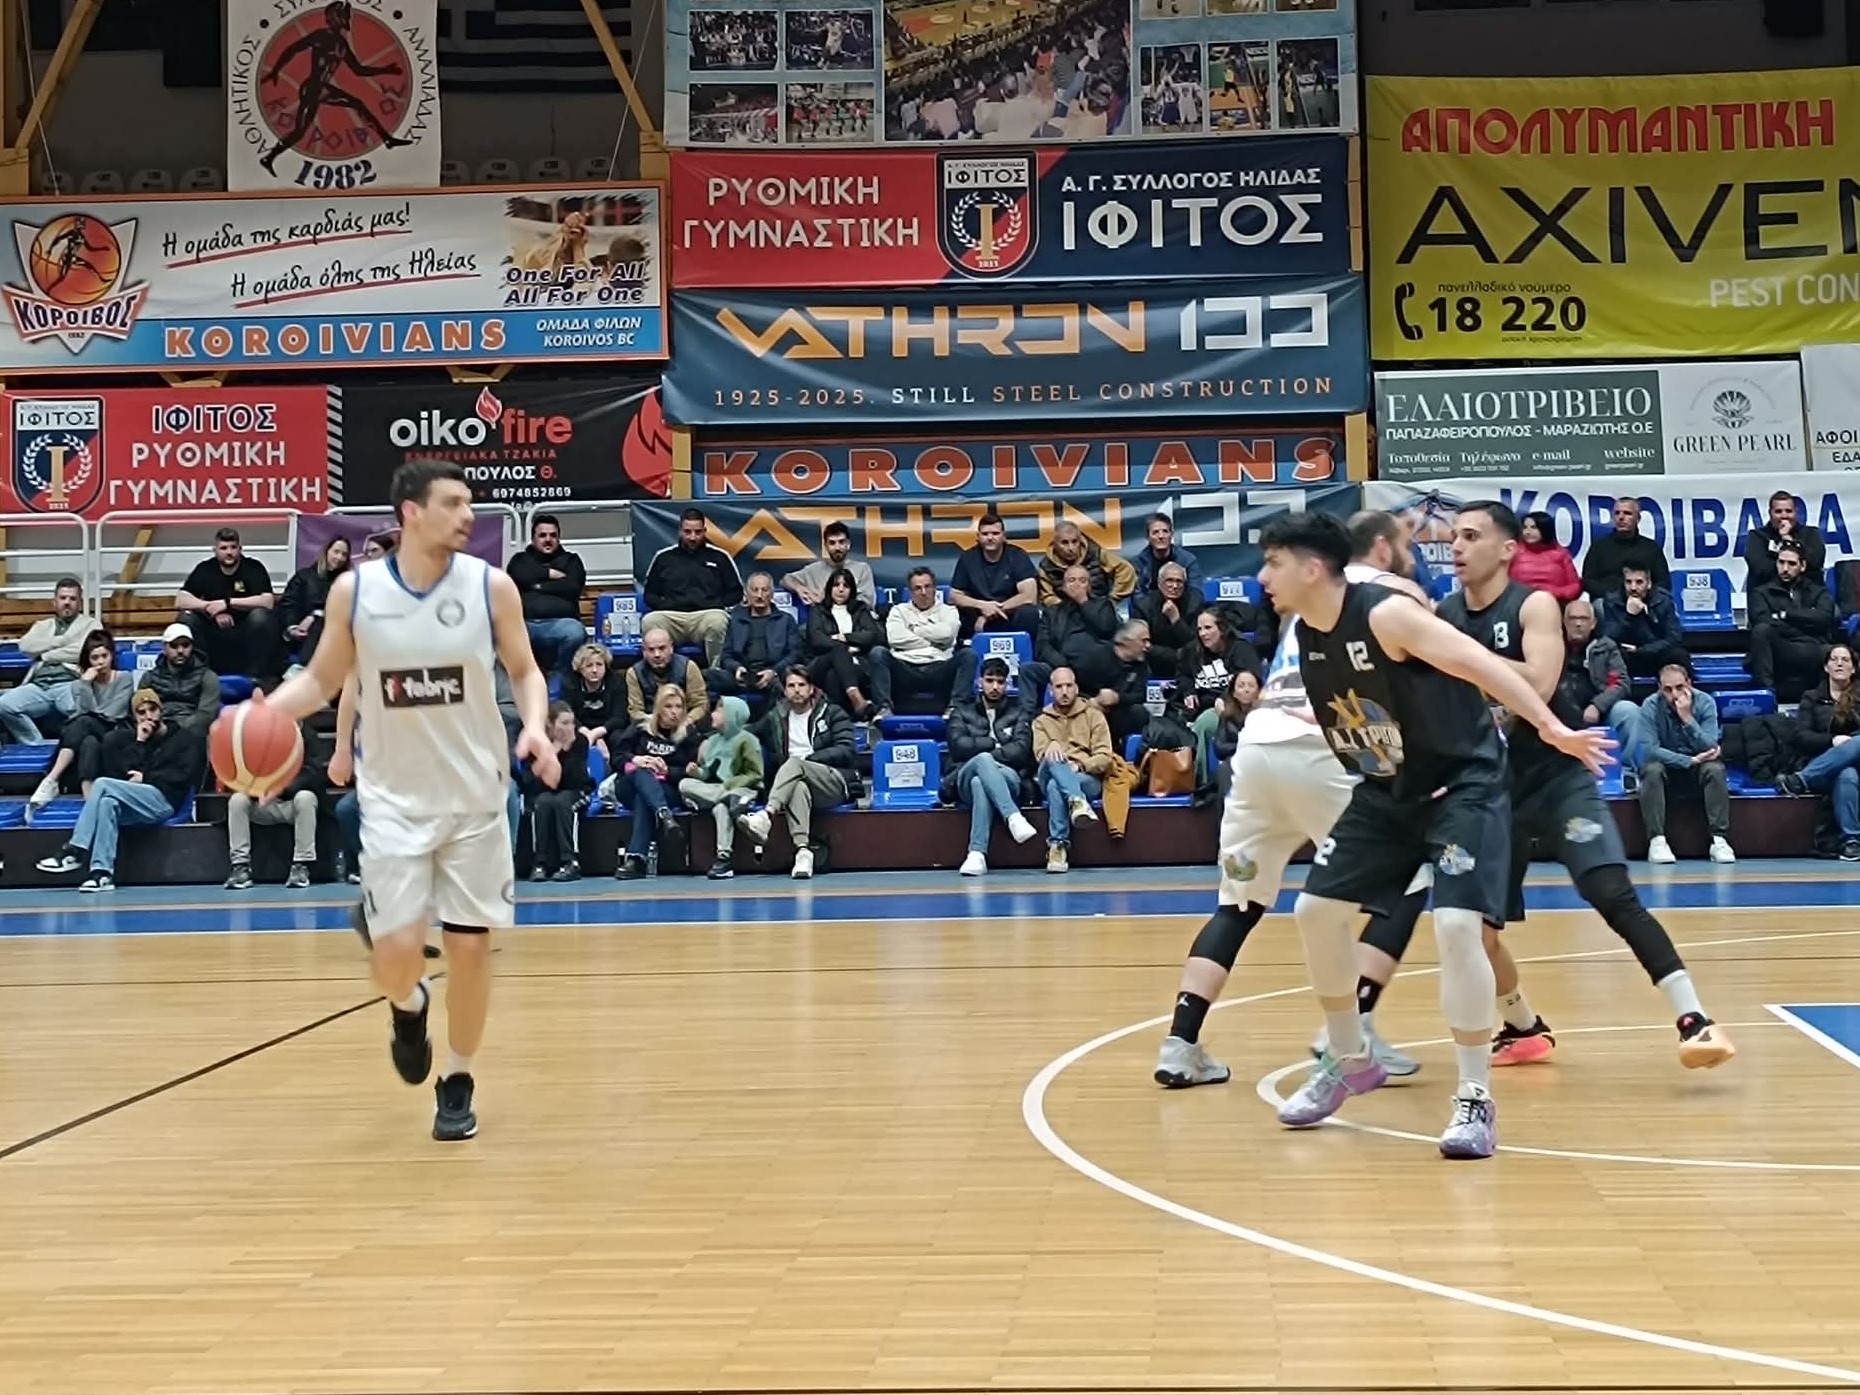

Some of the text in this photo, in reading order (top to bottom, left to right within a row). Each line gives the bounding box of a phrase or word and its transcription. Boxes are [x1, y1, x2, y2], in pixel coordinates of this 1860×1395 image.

[231, 35, 273, 154] ΑΘΛΗΤΙΚΟΣ
[1401, 98, 1835, 155] ΑΠΟΛΥΜΑΝΤΙΚΗ
[294, 160, 377, 190] 1982
[948, 169, 1026, 184] ΙΦΙΤΟΣ
[1061, 168, 1322, 192] Α. Γ. ΣΥΛΛΟΓΟΣ ΗΛΙΔΑΣ
[708, 176, 879, 206] ΡΥΘΜΙΚΗ
[162, 202, 411, 262] Η ομάδα της καρδιάς μας!
[684, 217, 919, 248] ΓΥΜΝΑΣΤΙΚΗ
[1062, 193, 1324, 251] ΙΦΙΤΟΣ
[231, 248, 477, 303] Η ομάδα όλης της Ηλείας
[505, 262, 646, 284] One For All
[503, 286, 644, 308] All For One
[1438, 281, 1572, 295] πανελλαδικό νούμερο
[1709, 277, 1786, 308] PEST
[13, 294, 139, 331] ΚΟΡΟΙΒΟΣ
[535, 316, 643, 333] ΟΜΑΔΑ ΦΙΛΩΝ
[1428, 295, 1587, 333] 18 220
[164, 318, 506, 358] KOROIVIANS
[543, 333, 635, 347] KOROIVOS BC
[892, 386, 976, 404] STILL
[992, 384, 1082, 403] STEEL
[1100, 376, 1332, 400] CONSTRUCTION
[20, 411, 95, 426] ΙΦΙΤΟΣ
[152, 403, 278, 434] ΙΦΙΤΟΣ
[1385, 387, 1651, 423] ΕΛΑΙΟΤΡΙΒΕΙΟ
[389, 408, 574, 447] oiko fire
[1386, 425, 1532, 440] ΠΑΠΑΖΑΦΕΙΡΟΠΟΥΛΟΣ
[1543, 423, 1630, 437] ΜΑΡΑΖΙΩΤΗΣ
[1816, 430, 1858, 444] ΑΦΟΙ
[131, 441, 286, 468] ΡΥΘΜΙΚΗ
[503, 449, 557, 459] ΤΖΑΚΙΑ
[1604, 446, 1656, 459] website
[1673, 433, 1797, 454] GREEN PEARL
[464, 466, 536, 481] ΠΟΥΛΟΣ
[704, 437, 1336, 496] KOROIVIANS
[108, 477, 321, 505] ΓΥΜΝΑΣΤΙΚΗ
[1345, 641, 1375, 671] 12
